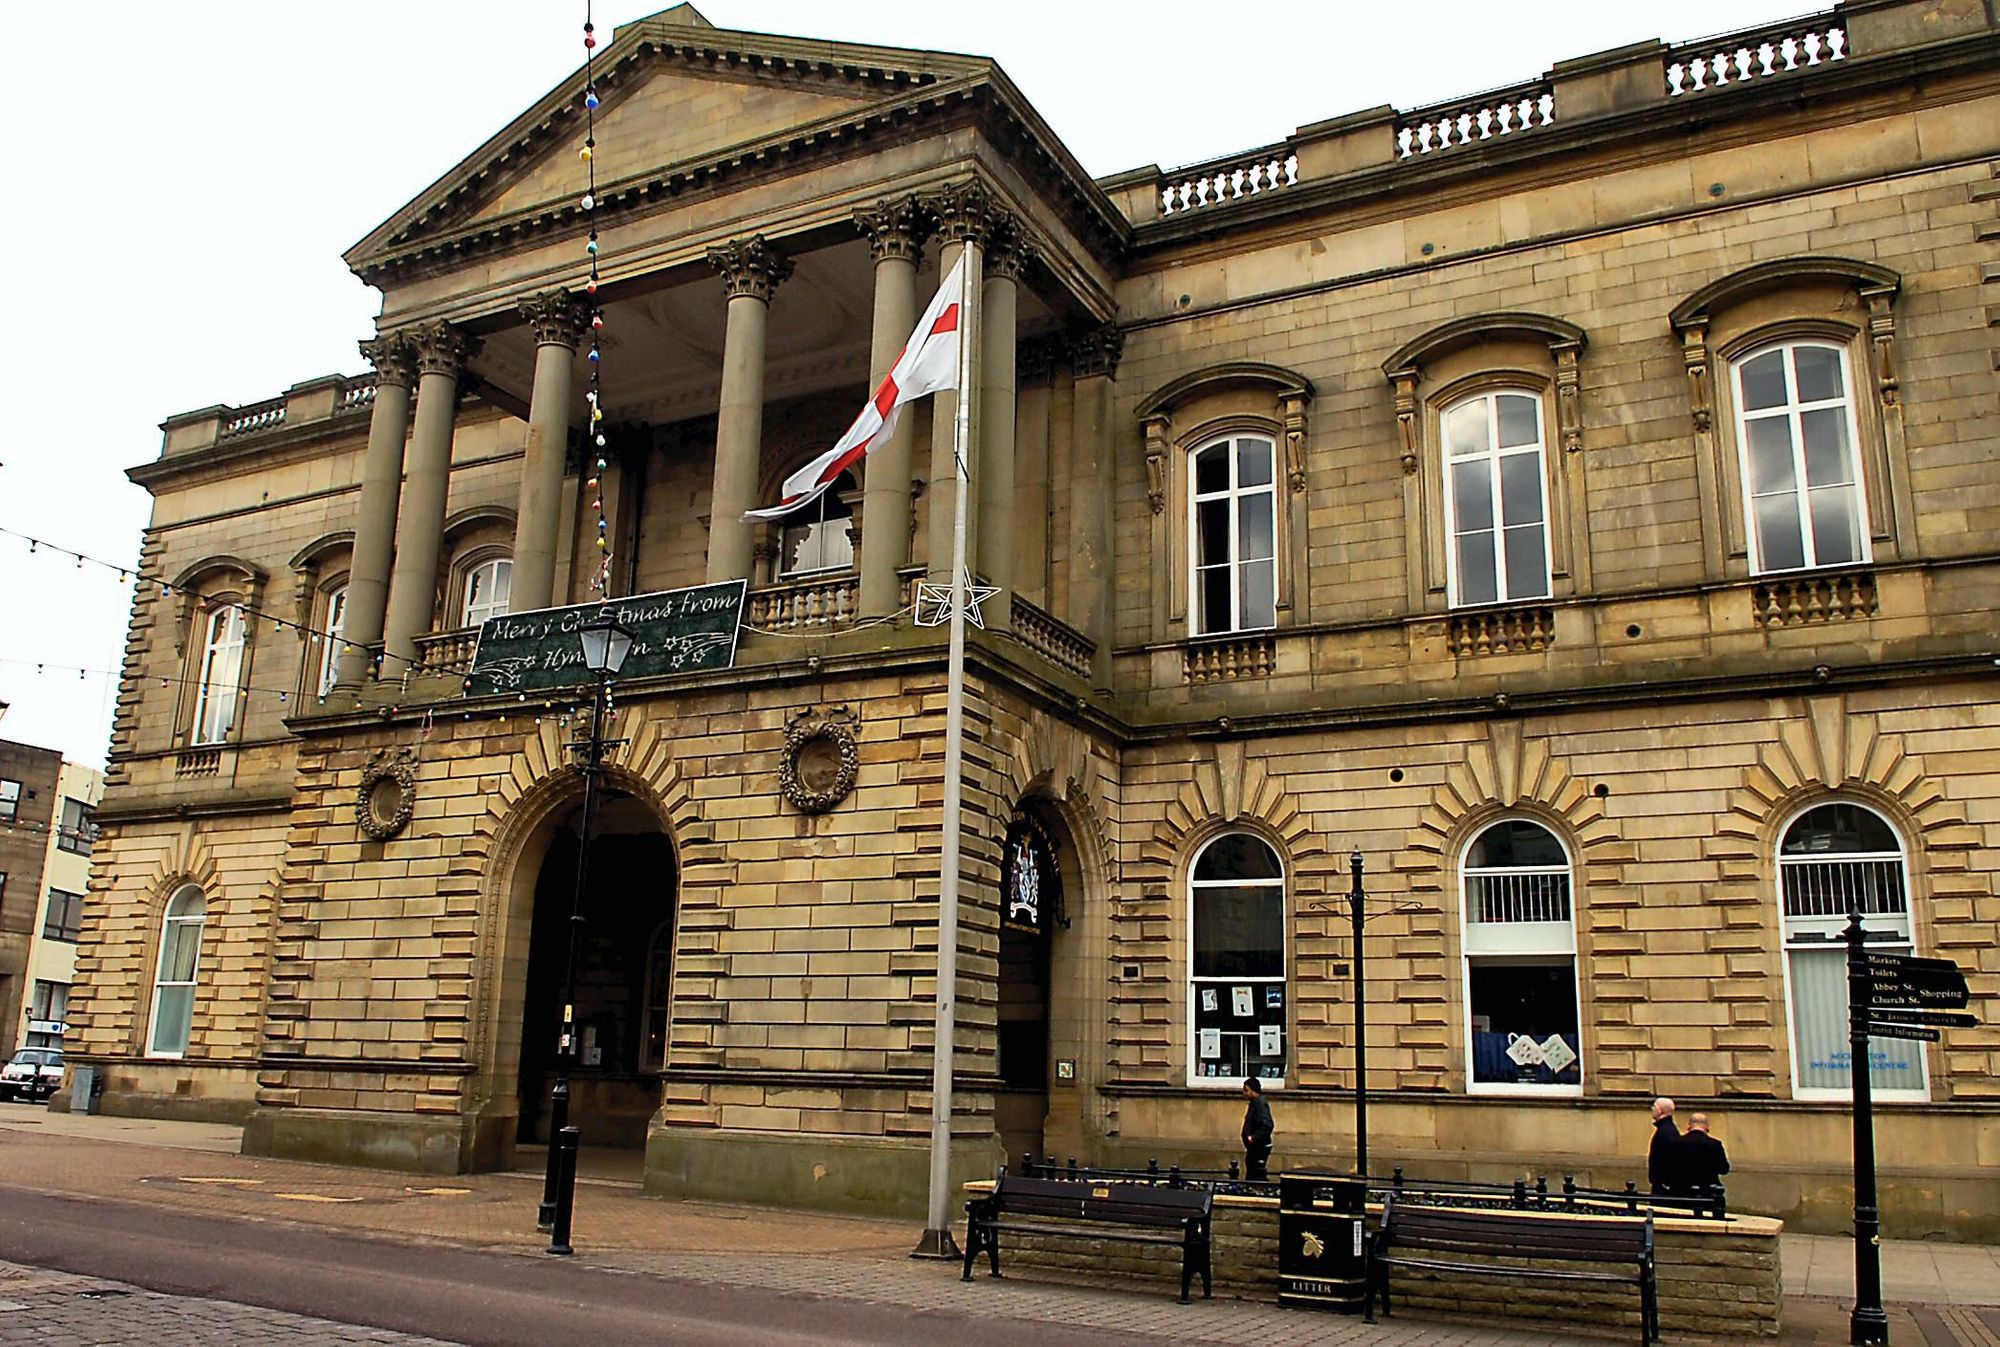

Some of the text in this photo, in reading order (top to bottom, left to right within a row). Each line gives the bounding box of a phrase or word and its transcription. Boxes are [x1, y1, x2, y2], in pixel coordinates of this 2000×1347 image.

[492, 591, 738, 640] Merry Chtmas from
[1868, 955, 1901, 965] Markets
[1869, 968, 1898, 977] Toilets
[1873, 982, 1915, 992] Abbey St.
[1920, 989, 1962, 999] Shopping
[1872, 995, 1920, 1004] Church St.
[1870, 1011, 1883, 1019] St.
[1869, 1025, 1935, 1039] Tourist Information
[1292, 1281, 1331, 1293] LITTER
